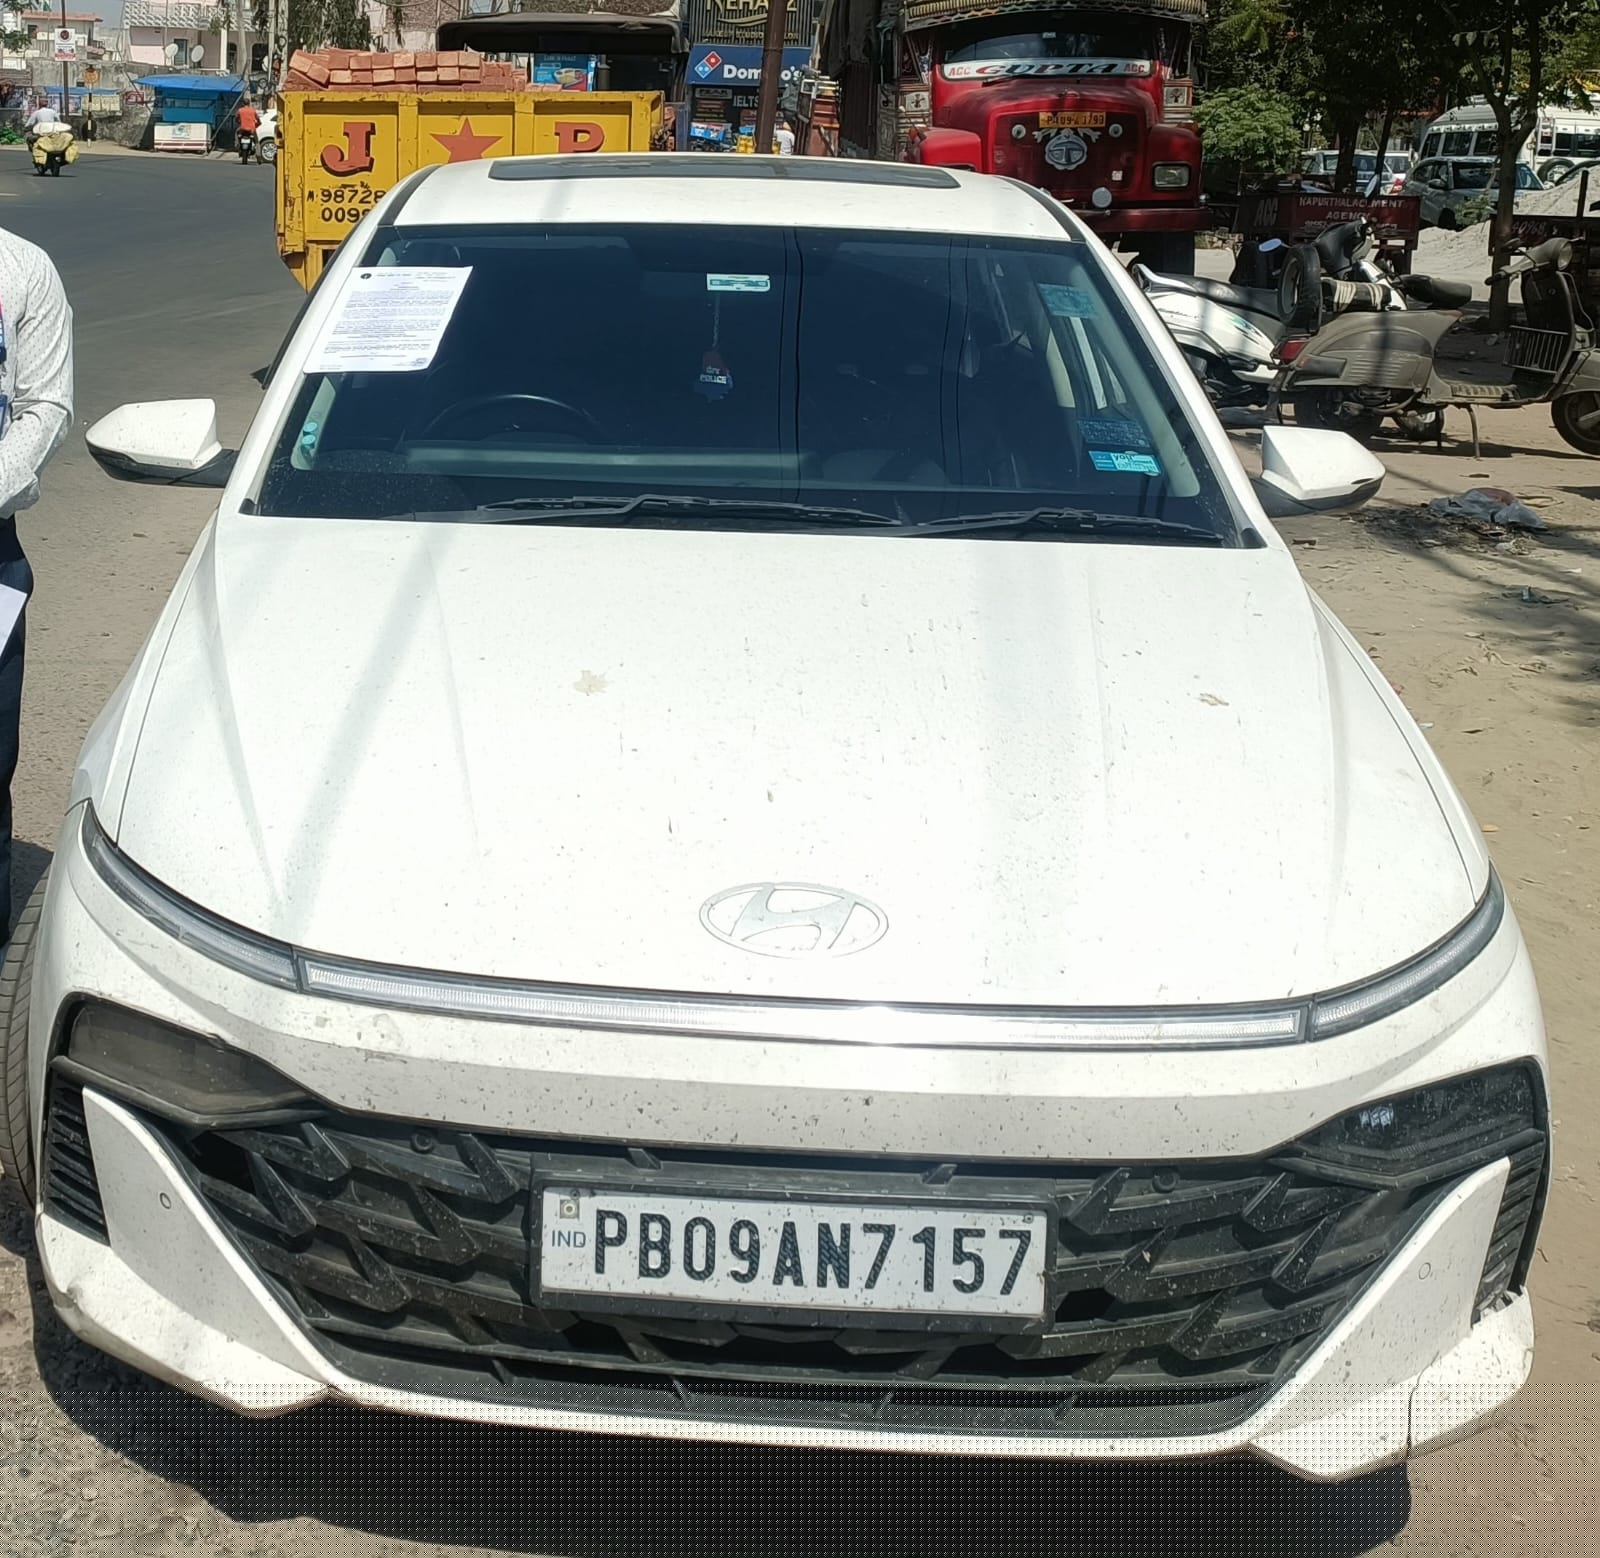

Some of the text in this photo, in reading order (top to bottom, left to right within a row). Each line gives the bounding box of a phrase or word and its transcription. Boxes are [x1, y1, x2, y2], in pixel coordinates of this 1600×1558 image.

[723, 64, 802, 81] Domo's
[976, 63, 1118, 75] GUPTA
[321, 121, 605, 177] J P
[700, 374, 726, 384] POLICE
[552, 1208, 1031, 1296] IND PB09AN7157
